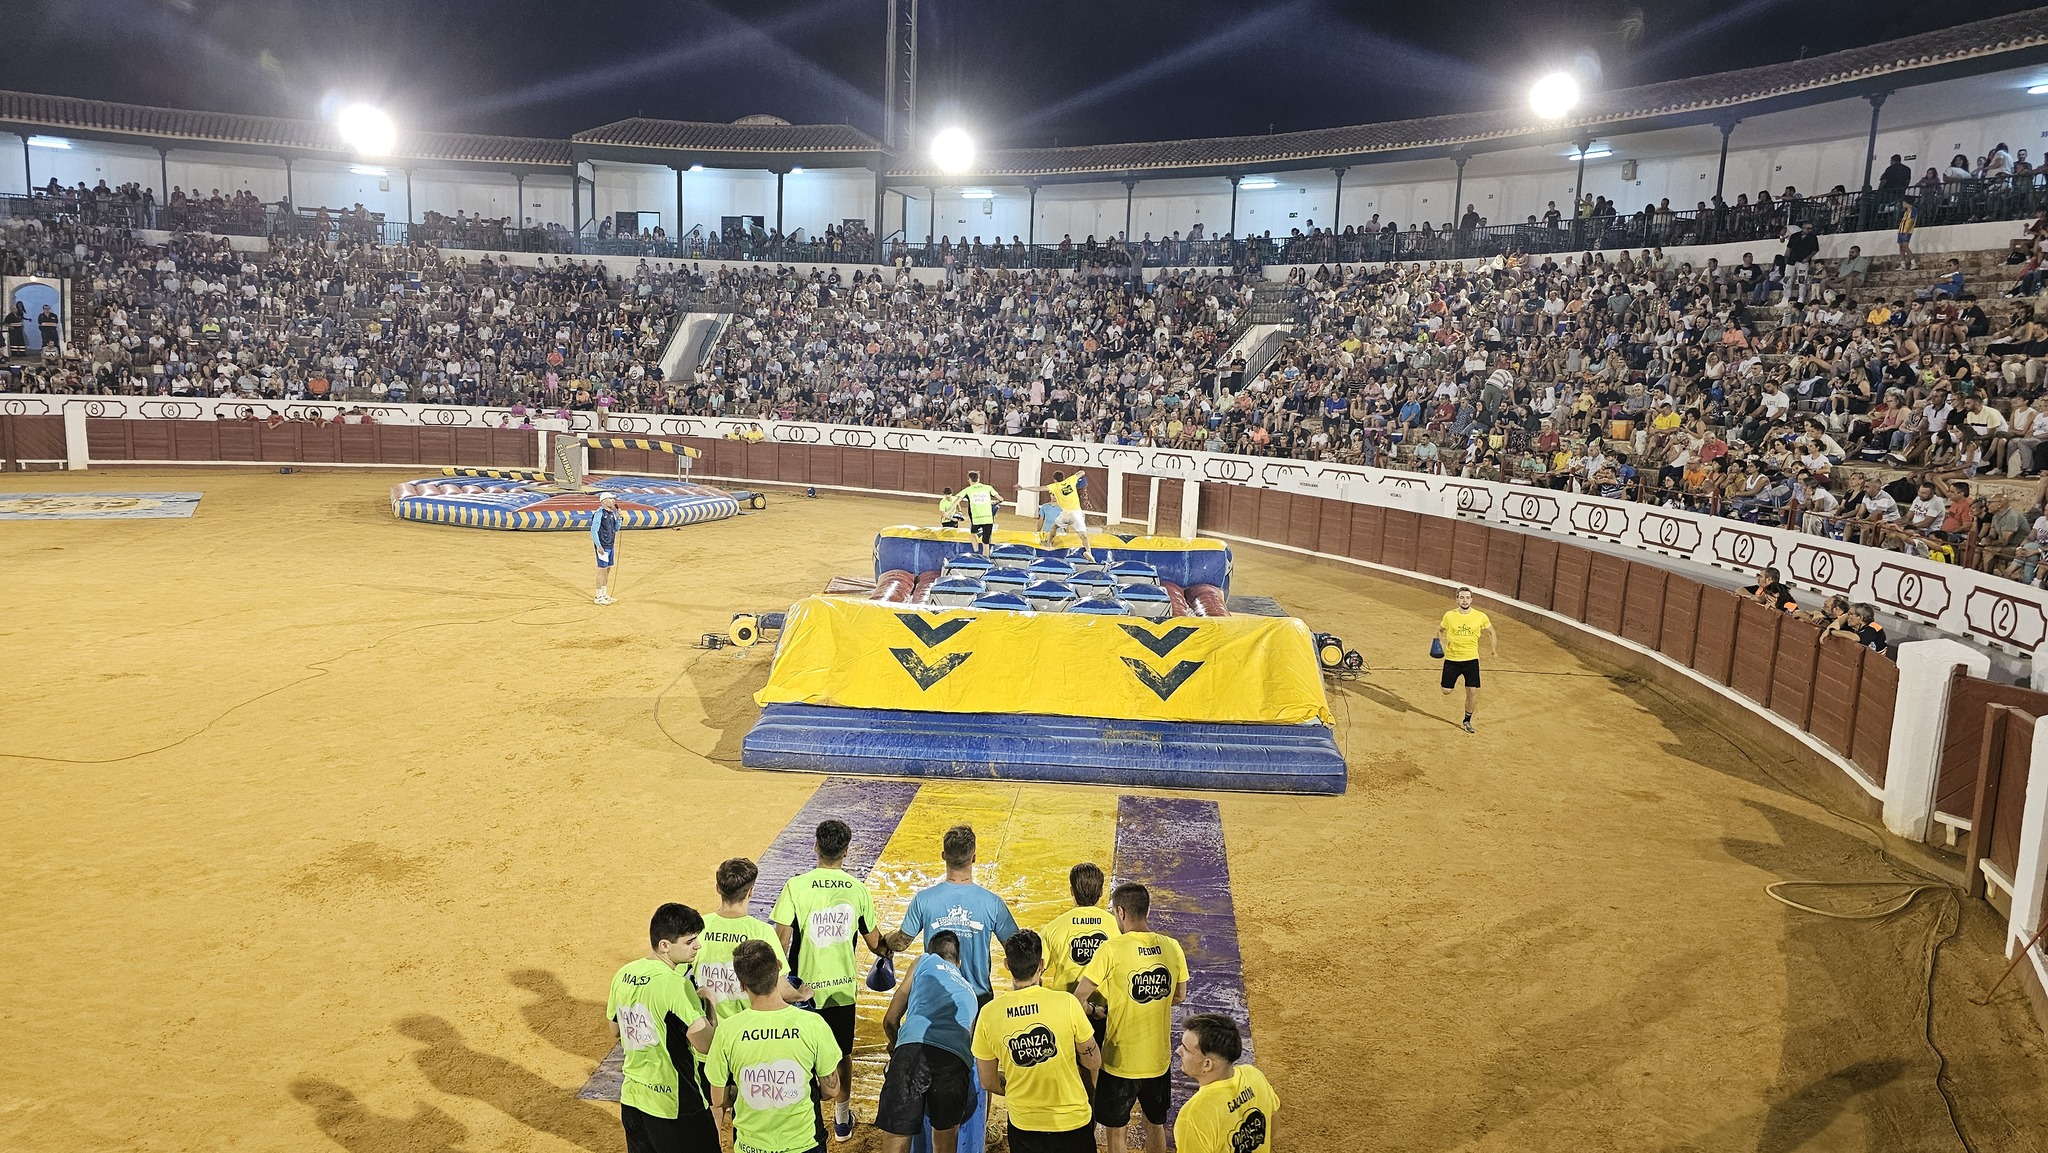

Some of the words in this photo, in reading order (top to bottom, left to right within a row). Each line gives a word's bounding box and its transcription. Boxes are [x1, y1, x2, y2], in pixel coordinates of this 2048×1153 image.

[12, 403, 18, 413] 7
[91, 404, 98, 415] 8
[168, 405, 174, 416] 8
[443, 412, 449, 422] 8
[623, 420, 628, 430] 8
[556, 444, 576, 484] ELIMINADOR
[1462, 491, 1468, 505] 2
[1526, 500, 1533, 516] 2
[1594, 511, 1602, 528] 2
[1664, 524, 1673, 542] 2
[1739, 539, 1748, 558] 2
[1817, 556, 1827, 578] 2
[1904, 578, 1914, 601] 2
[1999, 603, 2009, 631] 2
[812, 880, 852, 888] ALEXRO
[812, 912, 849, 924] MANZA
[704, 932, 748, 943] MERINO
[817, 925, 842, 937] PRIX
[1138, 946, 1162, 956] PEDRO
[702, 965, 738, 982] MANZ
[1134, 975, 1167, 985] MANZA
[1138, 986, 1160, 995] PRIX
[1007, 1003, 1039, 1018] MAGUTI
[741, 1028, 799, 1041] AGUILAR
[1011, 1034, 1049, 1049] MANZA
[1018, 1048, 1043, 1059] PRIX
[744, 1068, 795, 1084] MANZA
[751, 1084, 784, 1101] PRIX
